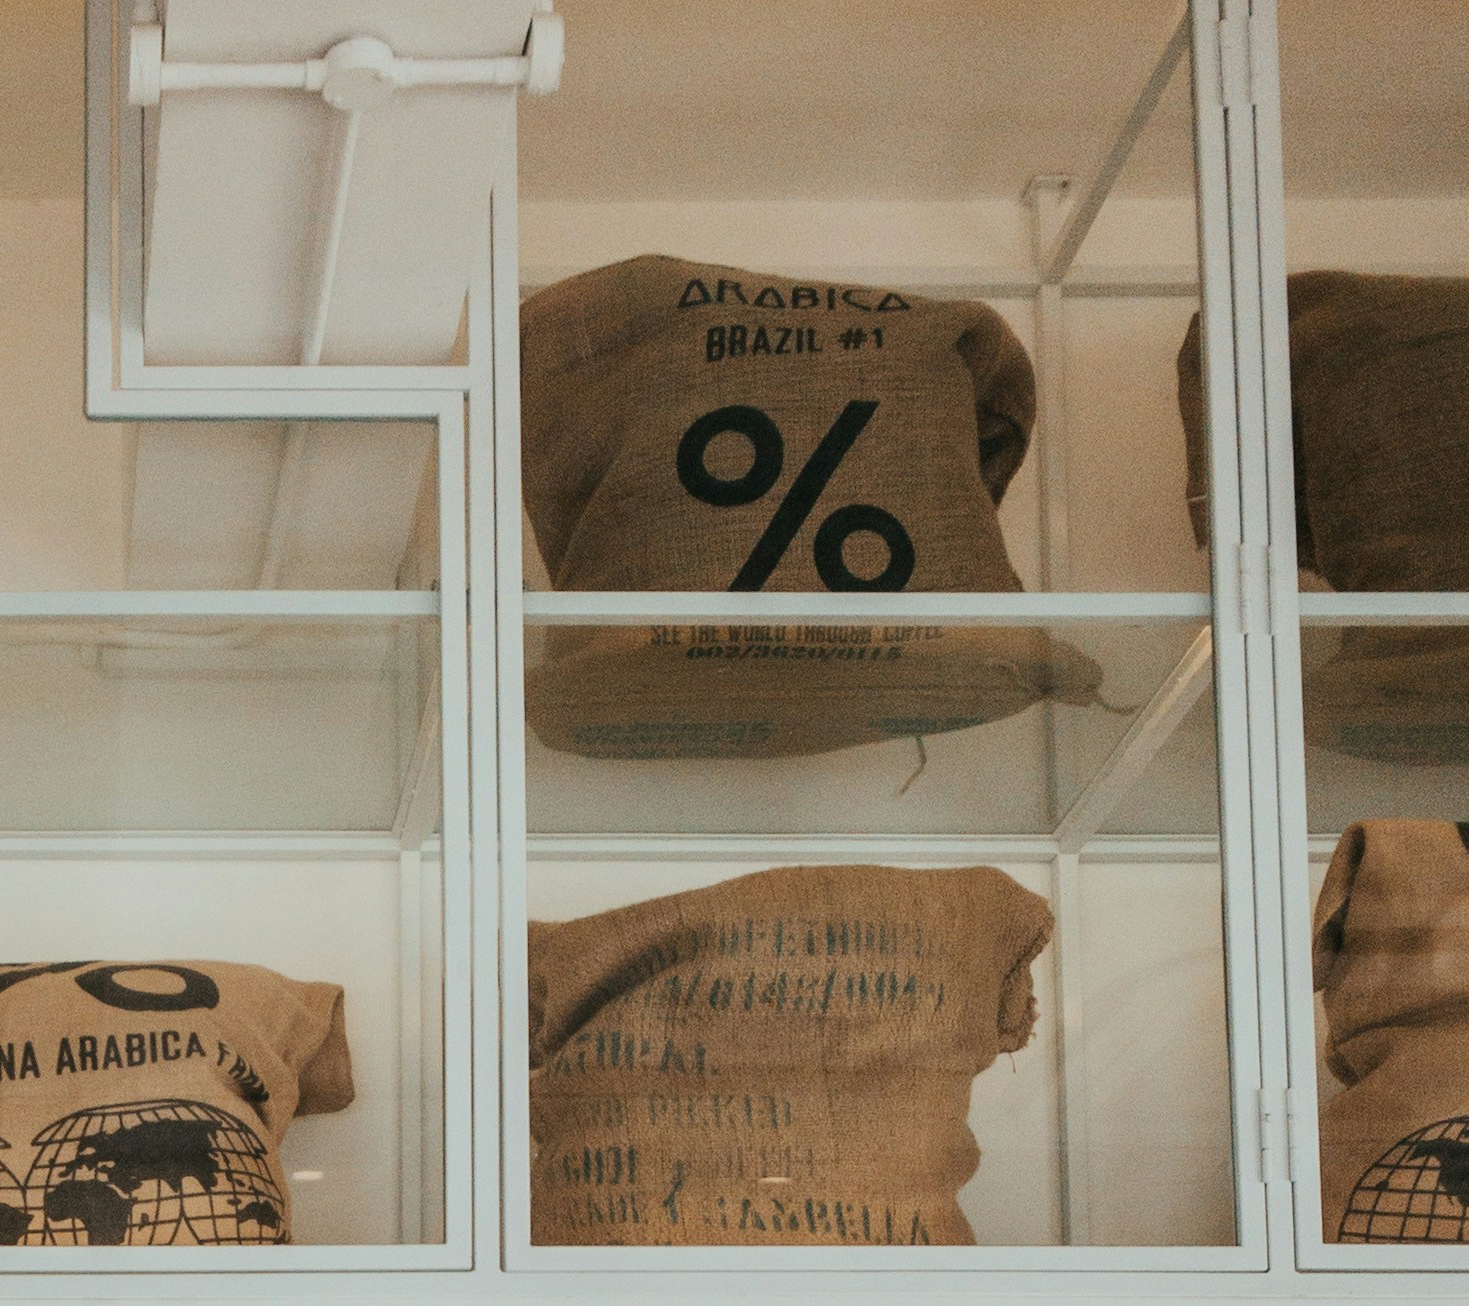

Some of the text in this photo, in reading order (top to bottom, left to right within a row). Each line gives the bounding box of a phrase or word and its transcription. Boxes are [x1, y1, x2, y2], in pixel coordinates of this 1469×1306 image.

[677, 278, 912, 312] ARABICA
[705, 325, 885, 363] BRAZIL #1
[56, 1029, 207, 1074] ARABICA
